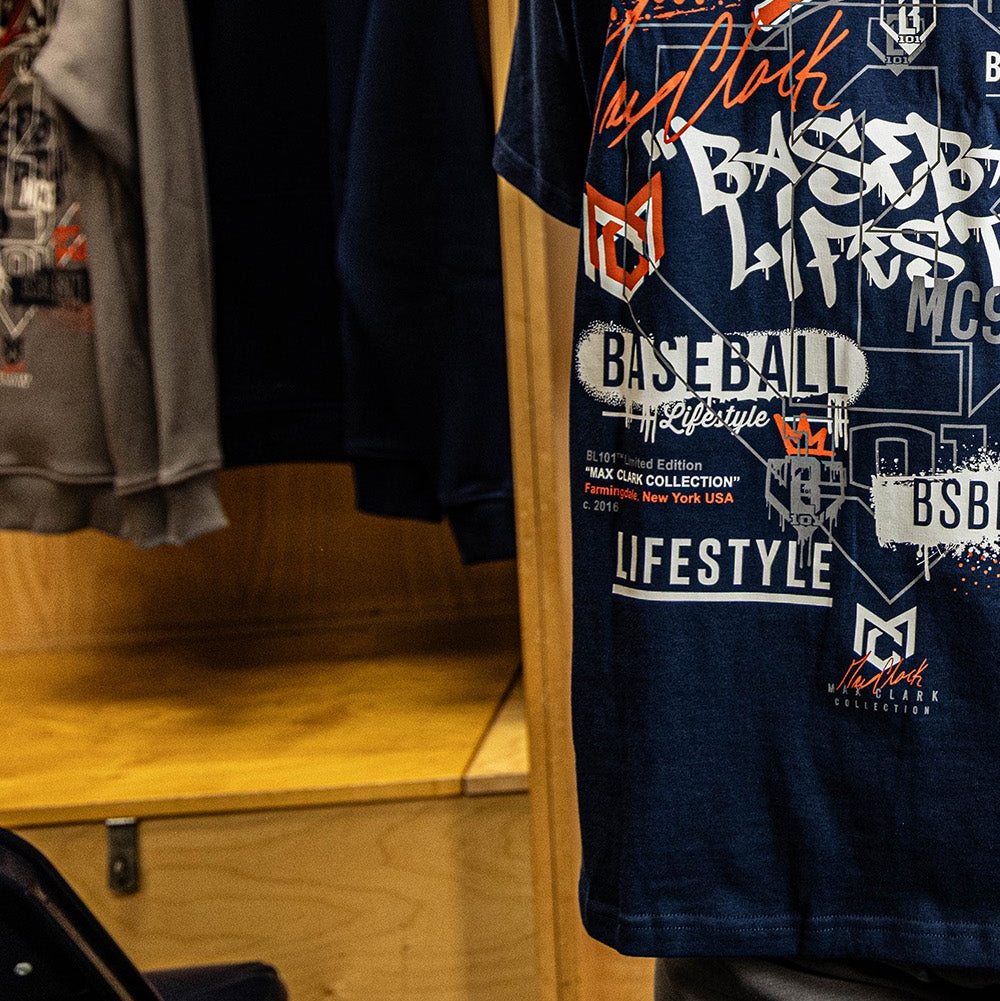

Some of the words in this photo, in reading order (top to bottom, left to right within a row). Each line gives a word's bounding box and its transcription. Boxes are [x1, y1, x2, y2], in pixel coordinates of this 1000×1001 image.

[898, 35, 921, 43] 101
[603, 331, 849, 394] BASEBALL
[659, 402, 771, 436] Lifestyle
[624, 455, 653, 470] Limited
[657, 458, 703, 471] Edition
[616, 468, 643, 486] CLARK
[593, 500, 620, 512] 2016
[642, 490, 669, 503] New
[671, 491, 701, 504] York
[705, 492, 735, 504] USA
[615, 531, 833, 591] LIFESTYLE
[827, 682, 862, 697] MAX
[875, 687, 940, 702] CLARK
[834, 697, 930, 715] COLLECTION
